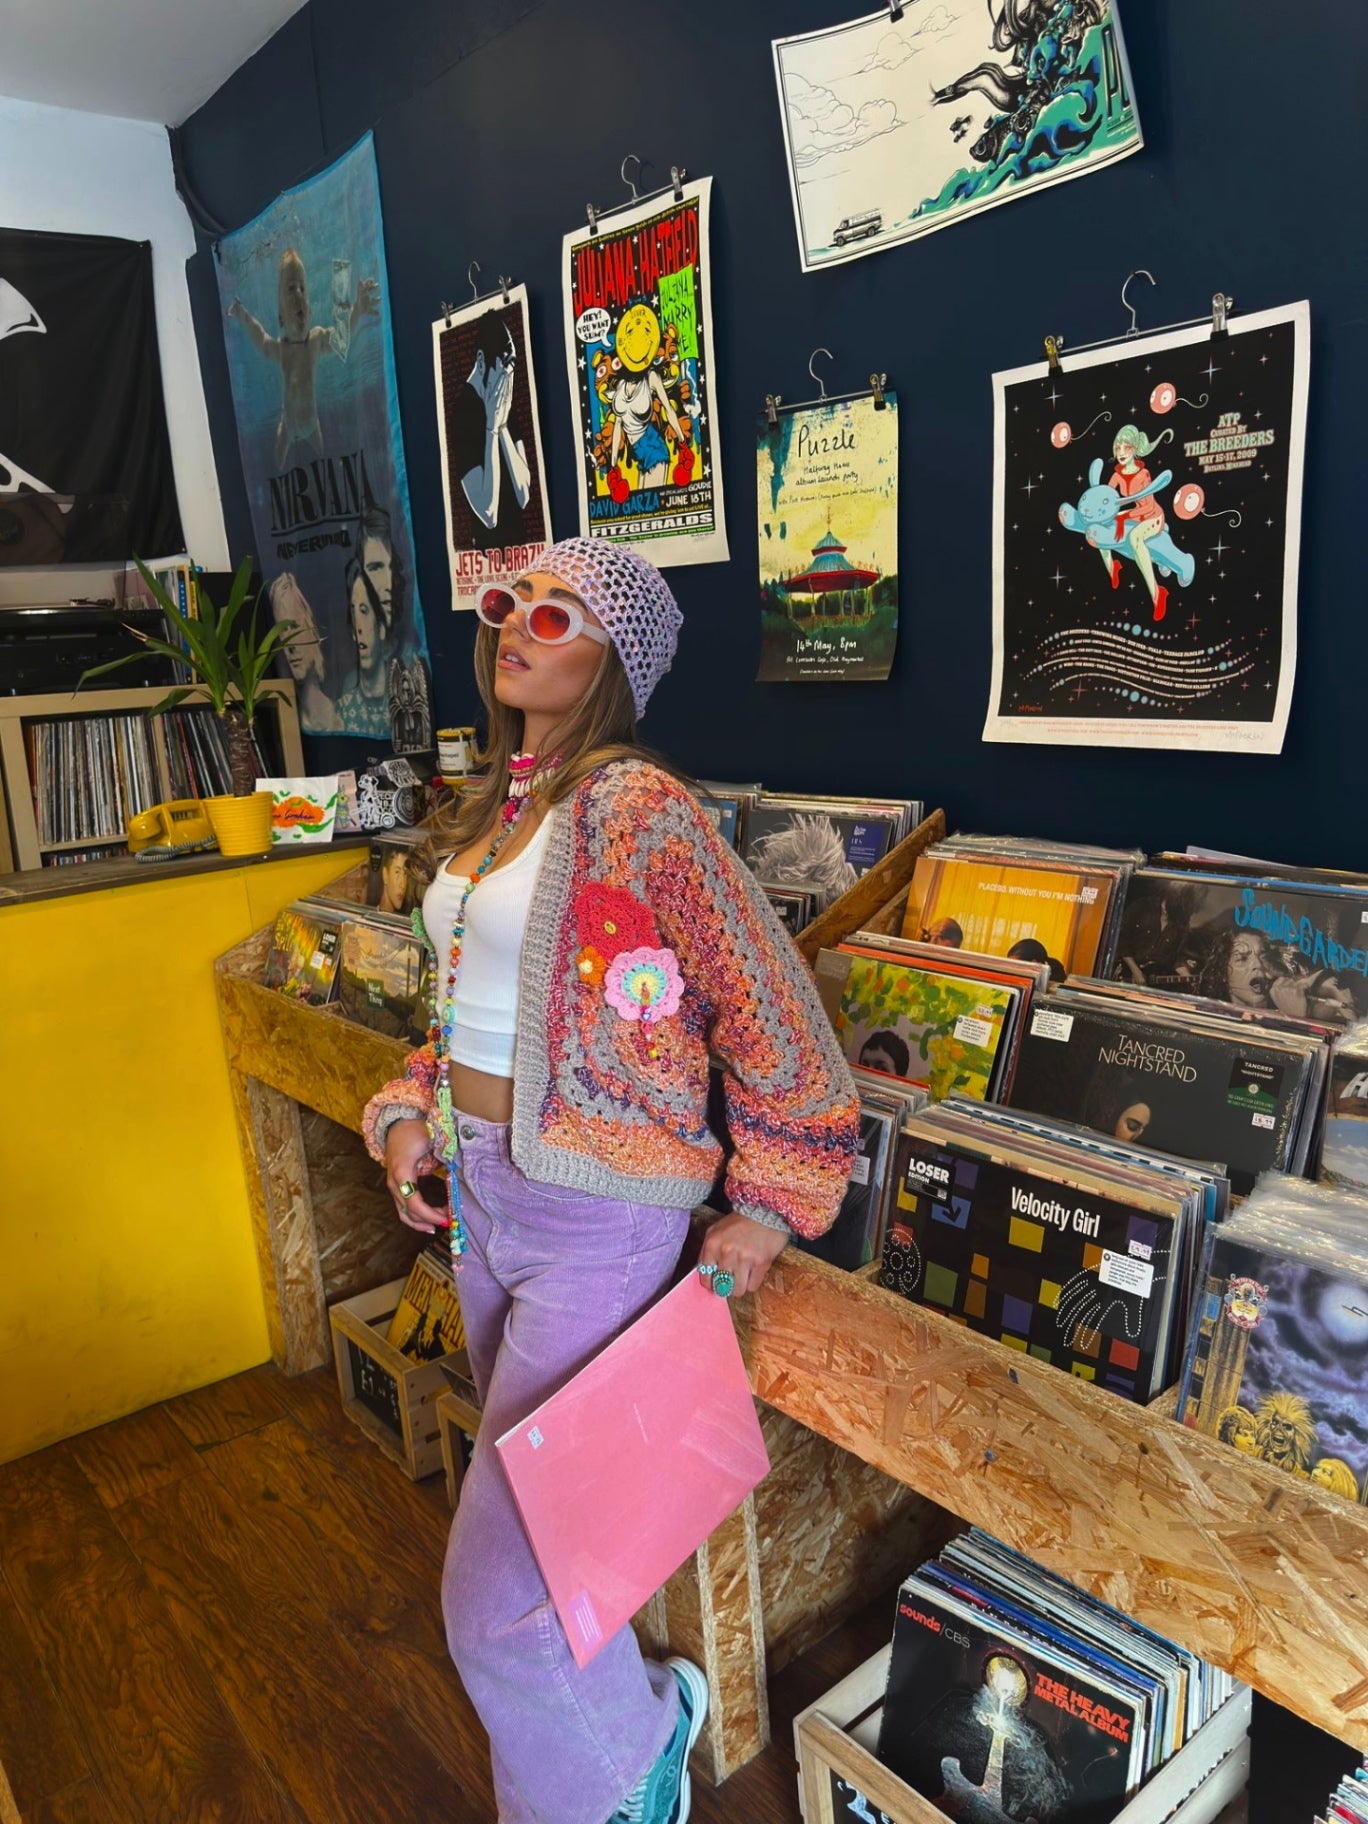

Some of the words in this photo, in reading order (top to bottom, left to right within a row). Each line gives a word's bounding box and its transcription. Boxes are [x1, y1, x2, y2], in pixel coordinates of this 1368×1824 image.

[574, 236, 637, 317] JULIANA
[638, 209, 698, 294] HATFIELD
[578, 325, 590, 333] YOU
[592, 319, 609, 330] WANT
[1217, 412, 1241, 428] ATP
[798, 425, 856, 458] Puzzle
[1184, 440, 1208, 457] THE
[1209, 429, 1275, 453] BREEDERS
[1198, 455, 1215, 466] MAY
[1237, 448, 1258, 459] 2009
[267, 449, 376, 531] NIRVANA
[589, 498, 620, 519] DAVID
[622, 491, 660, 515] GARZA
[666, 494, 689, 507] JUNE
[591, 512, 713, 537] FITZGERALDS
[456, 552, 482, 576] JETS
[486, 549, 502, 574] TO
[840, 636, 857, 652] 8pm
[1008, 886, 1037, 897] WITHOUT
[1038, 890, 1052, 899] YOU
[1119, 1034, 1185, 1063] TANCRED
[1098, 1047, 1197, 1082] NIGHTSTAND
[1244, 1061, 1274, 1073] TANCRED
[907, 1171, 930, 1184] EDITION
[908, 1157, 950, 1184] LOSER
[1011, 1186, 1071, 1232] Velocity
[1072, 1208, 1101, 1238] Girl
[1034, 1685, 1079, 1716] METAL
[1079, 1709, 1129, 1743] ALBUM
[1036, 1672, 1069, 1700] THE
[1070, 1690, 1130, 1730] HEAVY
